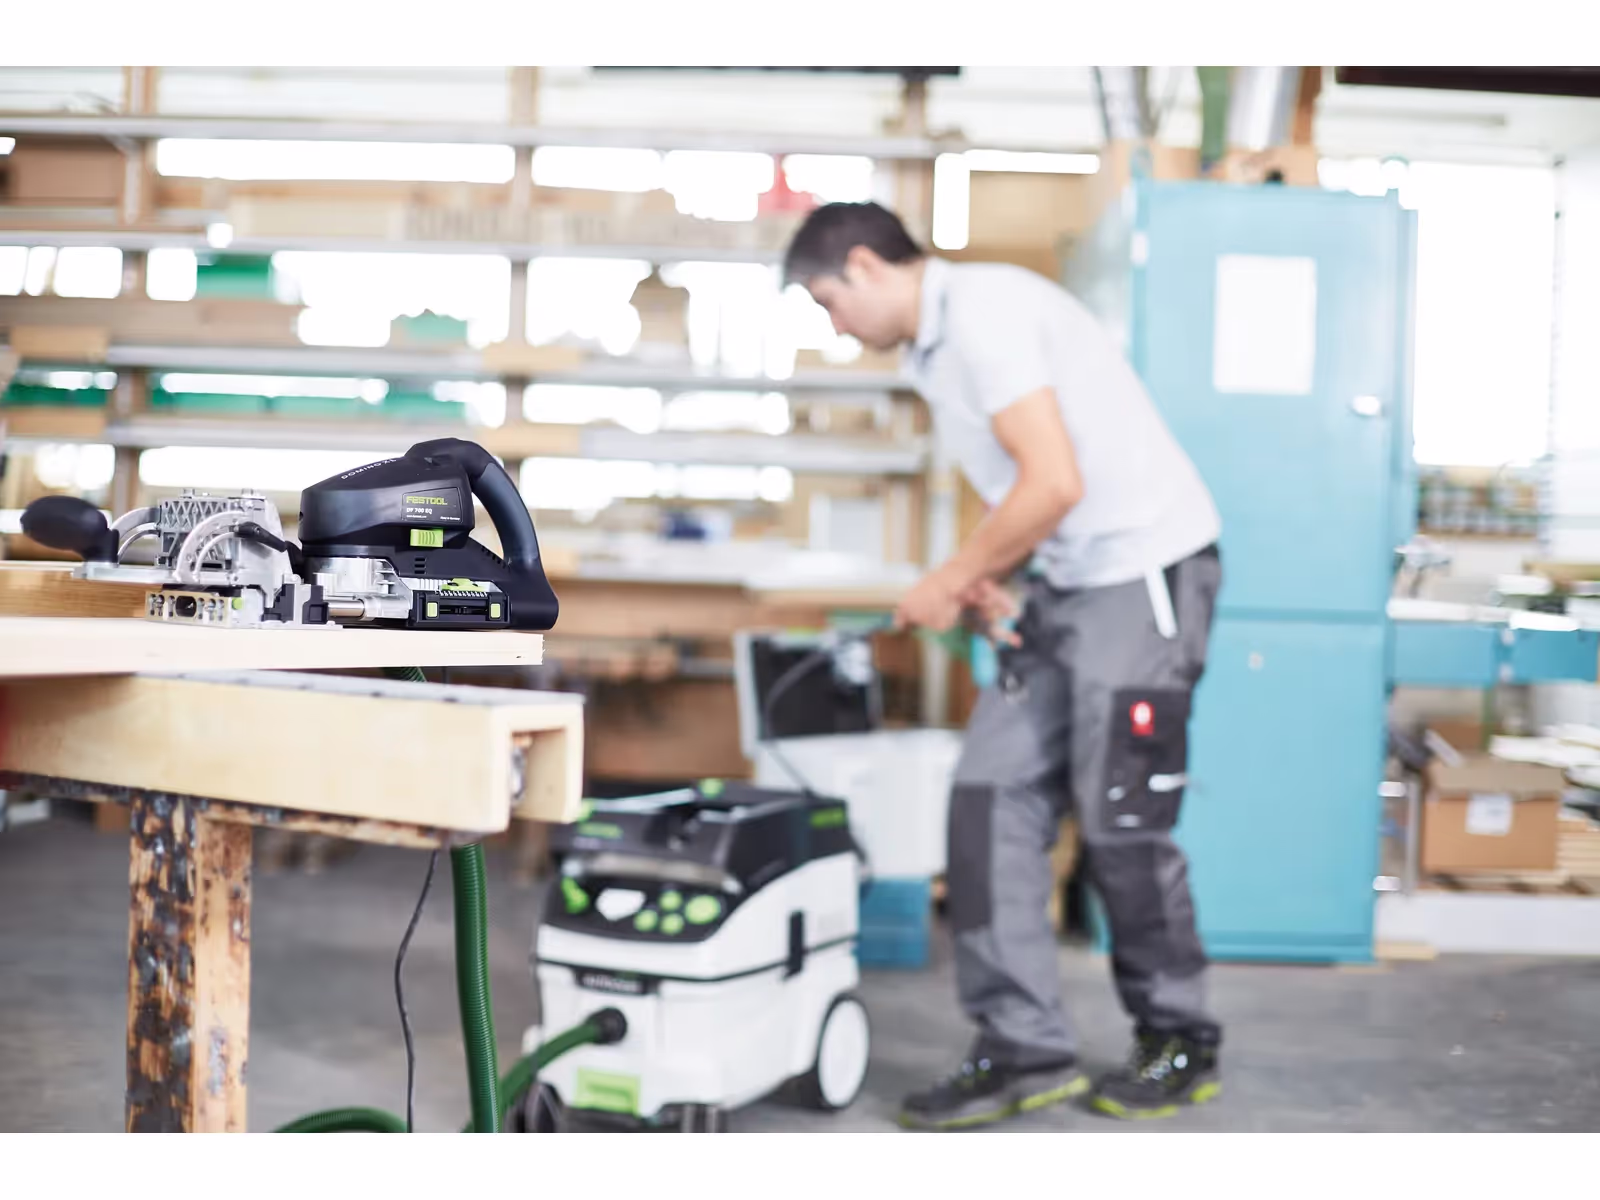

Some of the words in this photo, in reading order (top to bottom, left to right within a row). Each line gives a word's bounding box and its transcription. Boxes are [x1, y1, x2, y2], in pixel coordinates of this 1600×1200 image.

[341, 462, 382, 479] DOMINO
[406, 496, 448, 505] FESTOOL
[425, 507, 433, 515] EQ
